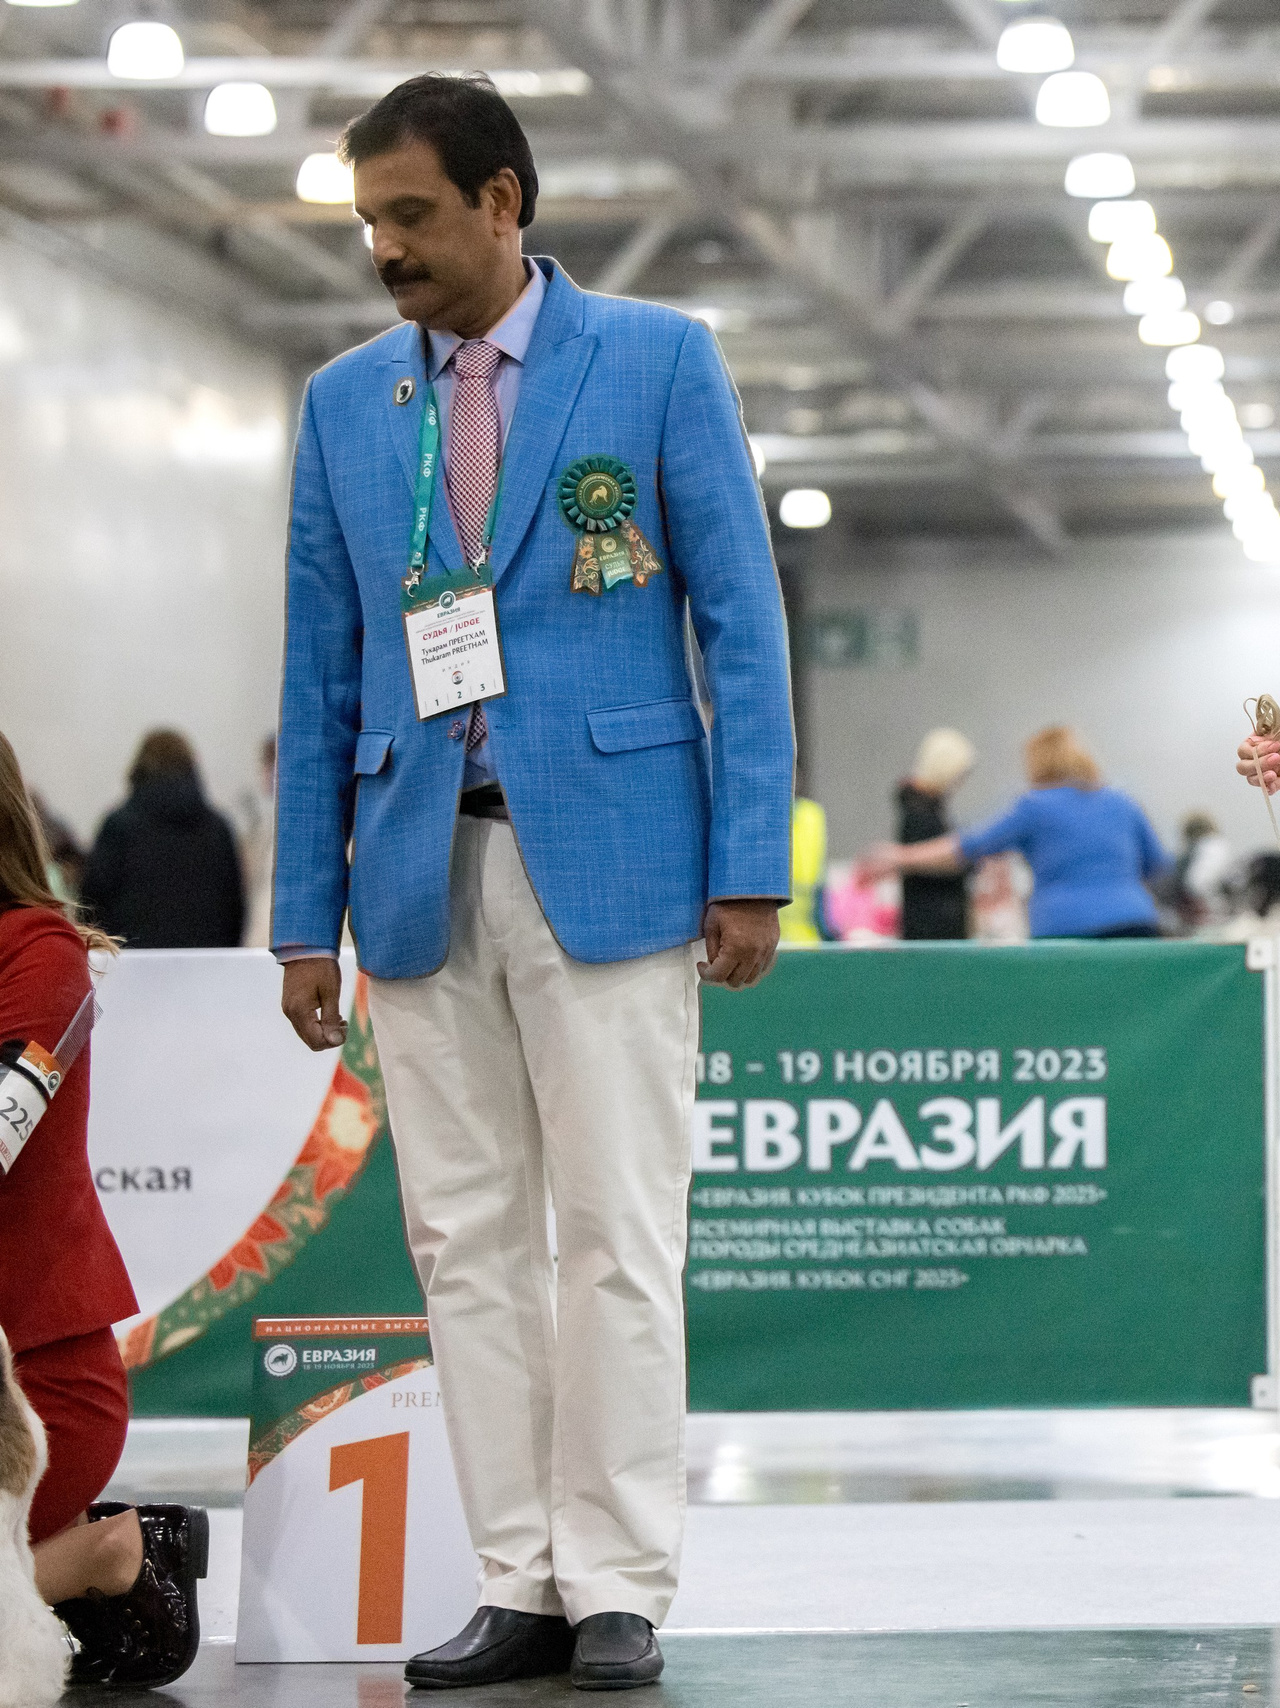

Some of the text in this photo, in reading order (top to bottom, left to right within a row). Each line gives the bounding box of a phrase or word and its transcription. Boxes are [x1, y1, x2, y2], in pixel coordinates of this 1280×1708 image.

[423, 453, 433, 477] РКФ
[418, 507, 427, 531] РКФ
[422, 627, 448, 641] СУДЬЯ
[455, 617, 480, 632] JUDGE
[421, 629, 486, 656] Тукарам ПРЕЕТХАМ
[421, 638, 489, 665] Thukaram PREETHAM
[457, 691, 462, 699] 2
[480, 683, 485, 691] 3
[696, 1051, 732, 1084] 18
[778, 1050, 821, 1084] 19
[834, 1048, 1000, 1083] НОЯБРЯ
[1012, 1048, 1107, 1081] 2023
[692, 1096, 1107, 1172] ЕВРАЗИЯ
[95, 1166, 192, 1192] ская
[265, 1323, 377, 1333] НАЦИОНАЛЬНЫЕ
[302, 1349, 376, 1363] ЕВРАЗИЯ
[328, 1431, 411, 1645] 1
